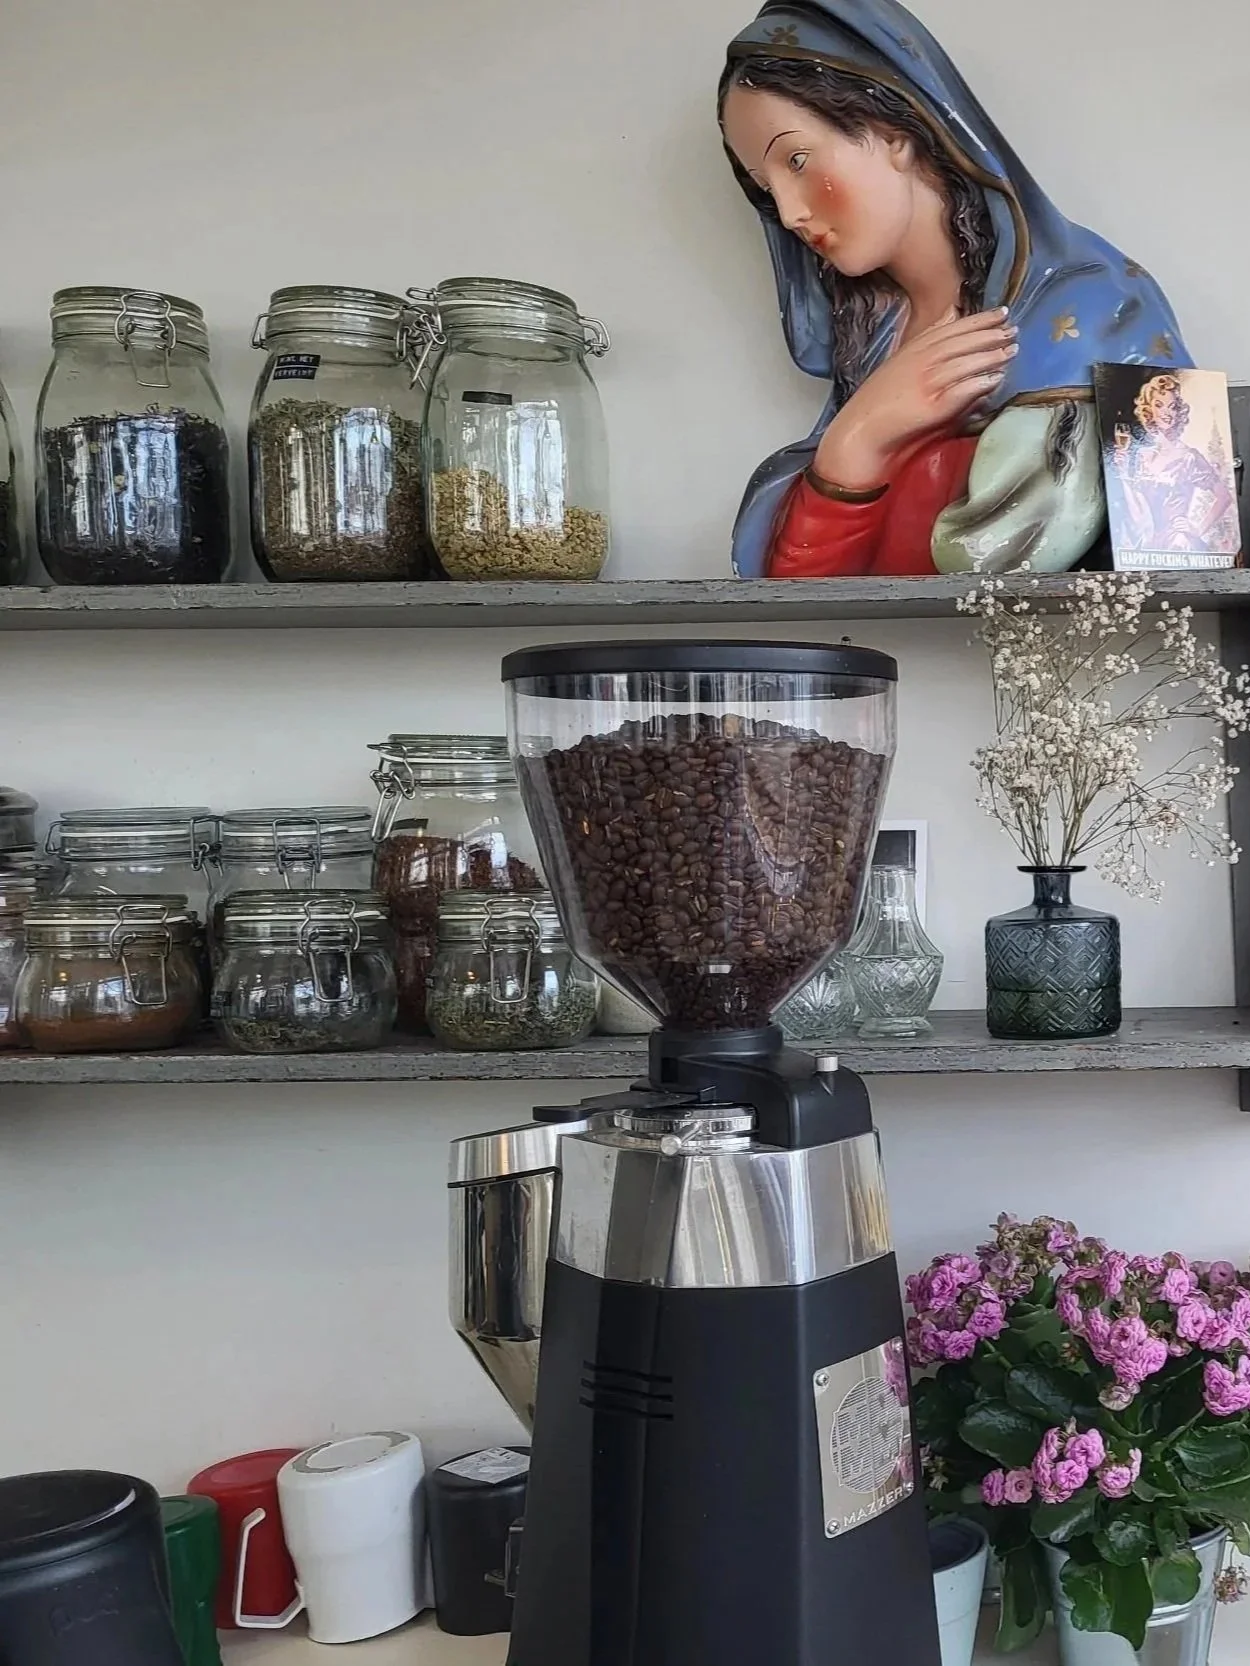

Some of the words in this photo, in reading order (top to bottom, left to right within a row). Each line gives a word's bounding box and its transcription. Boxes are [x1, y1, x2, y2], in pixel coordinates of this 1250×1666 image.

[1121, 551, 1149, 566] HAPPY
[1151, 553, 1188, 567] FUCKING
[843, 1488, 902, 1526] MAZZER
